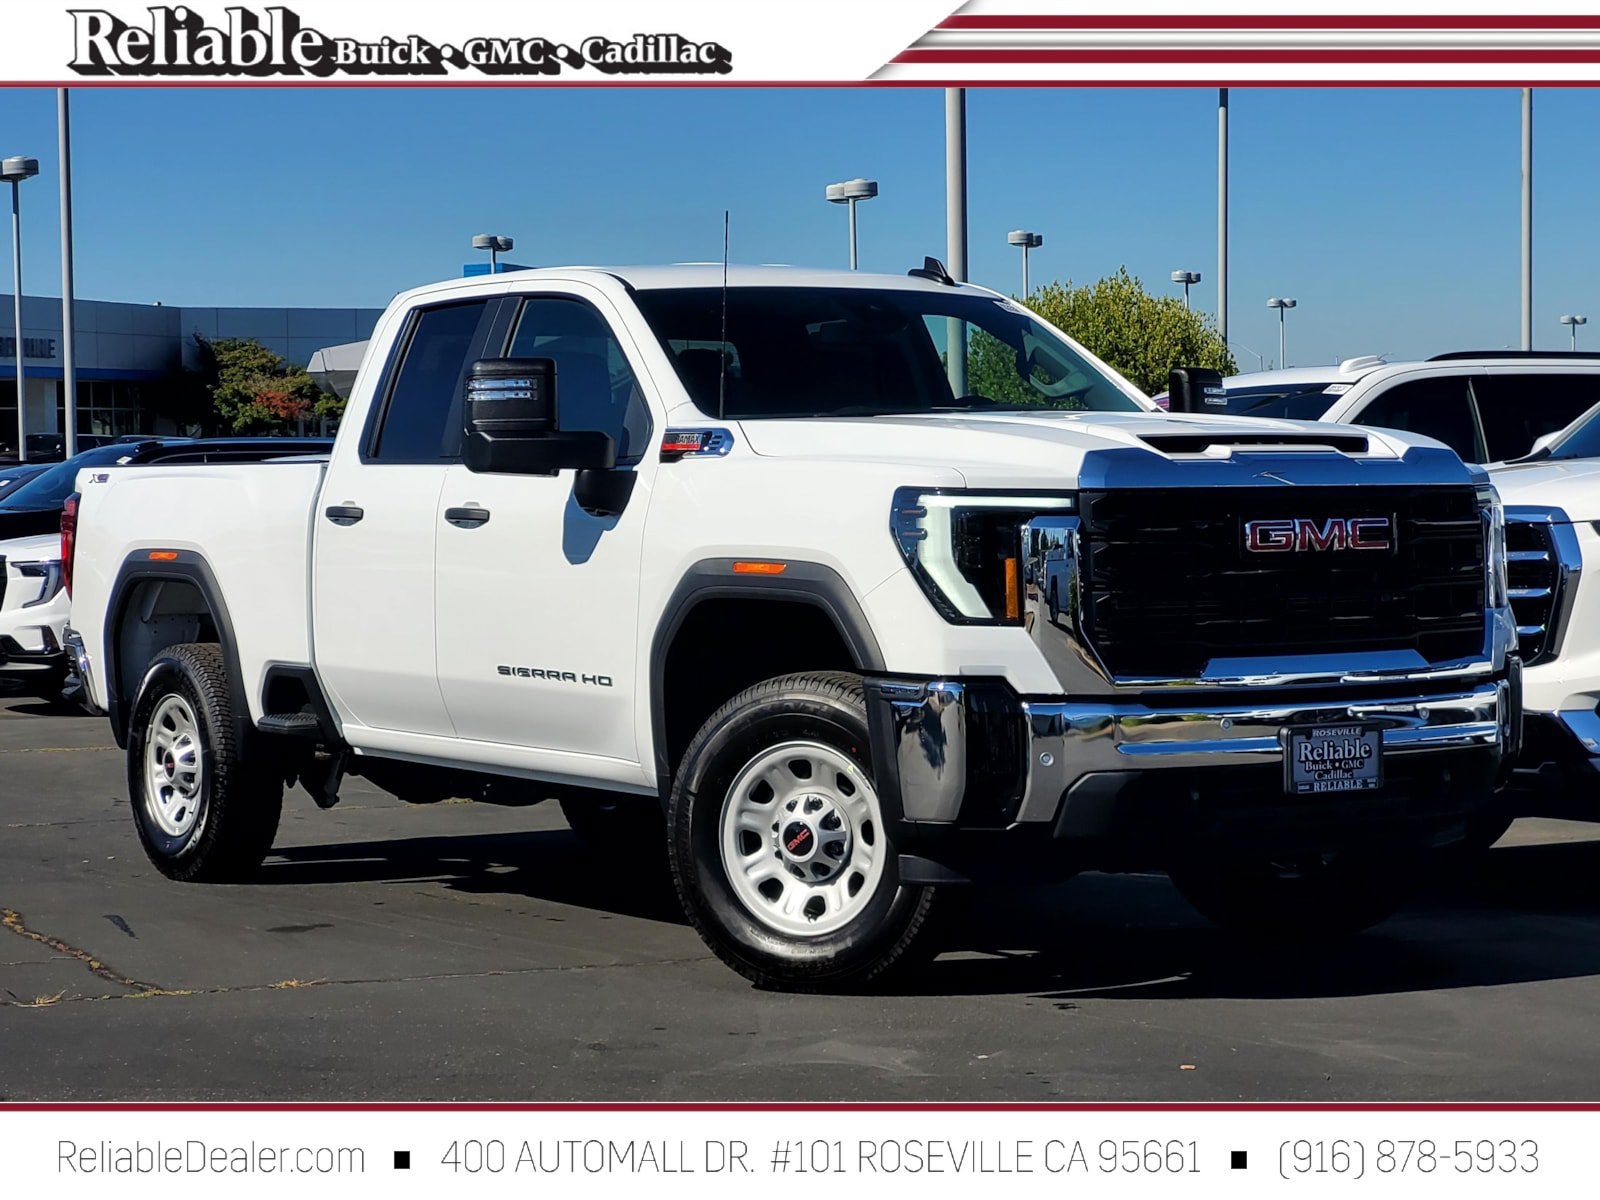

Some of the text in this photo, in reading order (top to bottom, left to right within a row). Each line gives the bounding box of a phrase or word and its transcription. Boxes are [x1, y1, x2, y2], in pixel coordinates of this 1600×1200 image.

[1244, 517, 1390, 553] GMC
[496, 664, 614, 688] SIERRA HD
[1312, 727, 1361, 737] ROSEVILLE
[1300, 739, 1370, 760] Reliable
[1304, 759, 1364, 771] Buick GMC
[1314, 769, 1353, 781] Cadillac
[1313, 780, 1362, 792] RELIABLE
[787, 828, 810, 851] GMC
